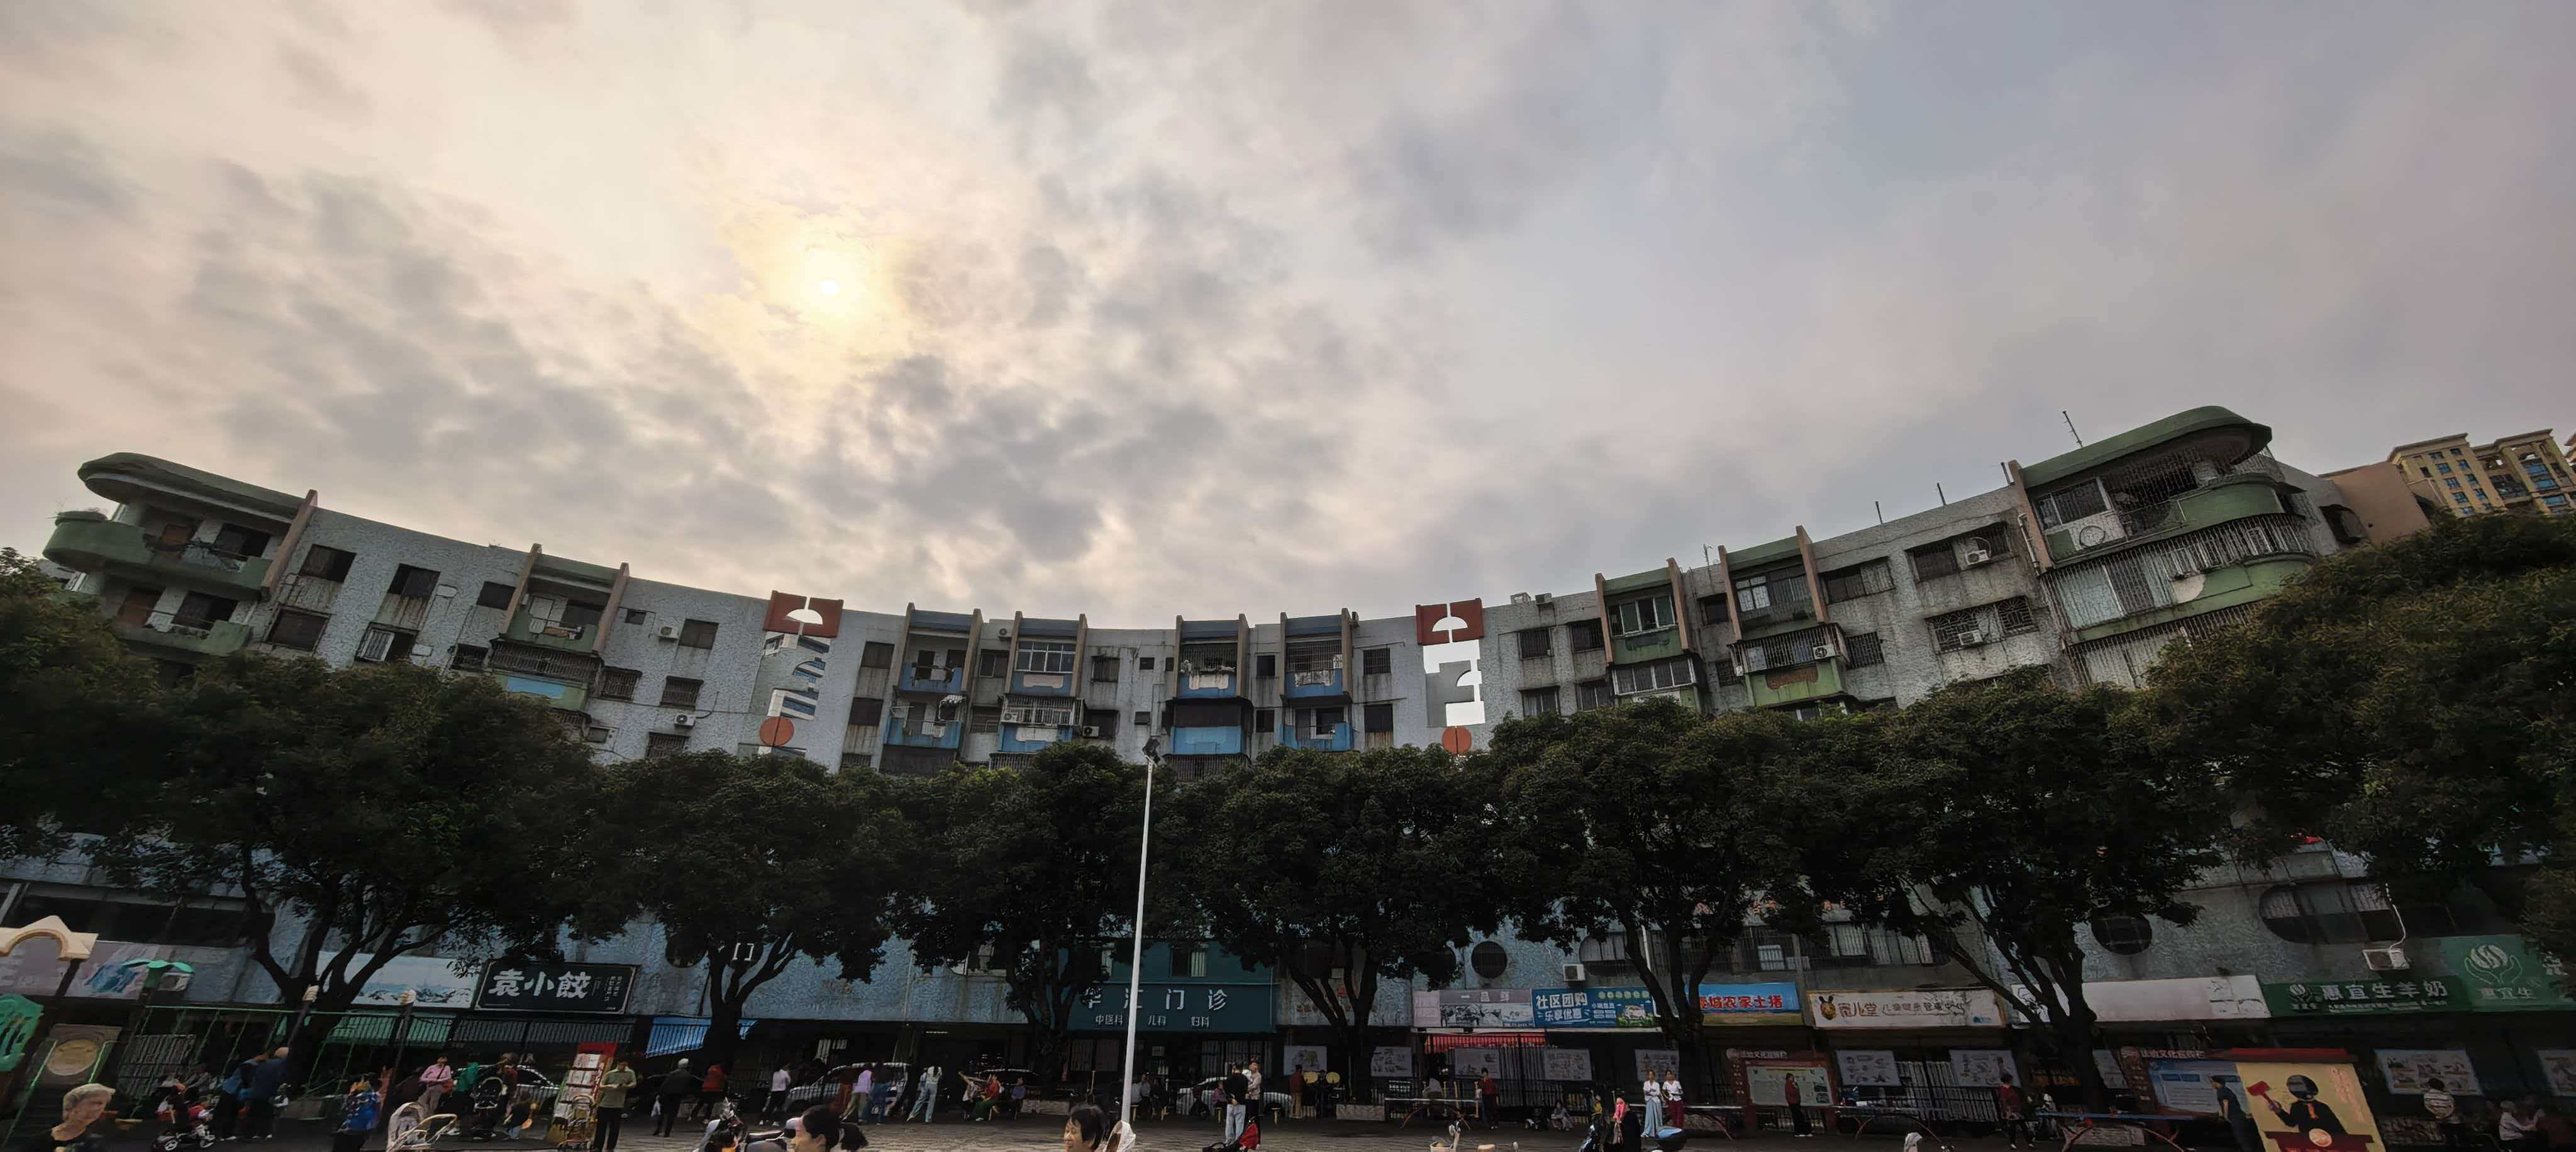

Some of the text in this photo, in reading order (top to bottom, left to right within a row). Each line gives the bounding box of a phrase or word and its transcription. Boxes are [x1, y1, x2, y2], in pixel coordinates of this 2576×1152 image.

[1536, 992, 1588, 1010] 社区团购
[1095, 1014, 1123, 1026] 中医科
